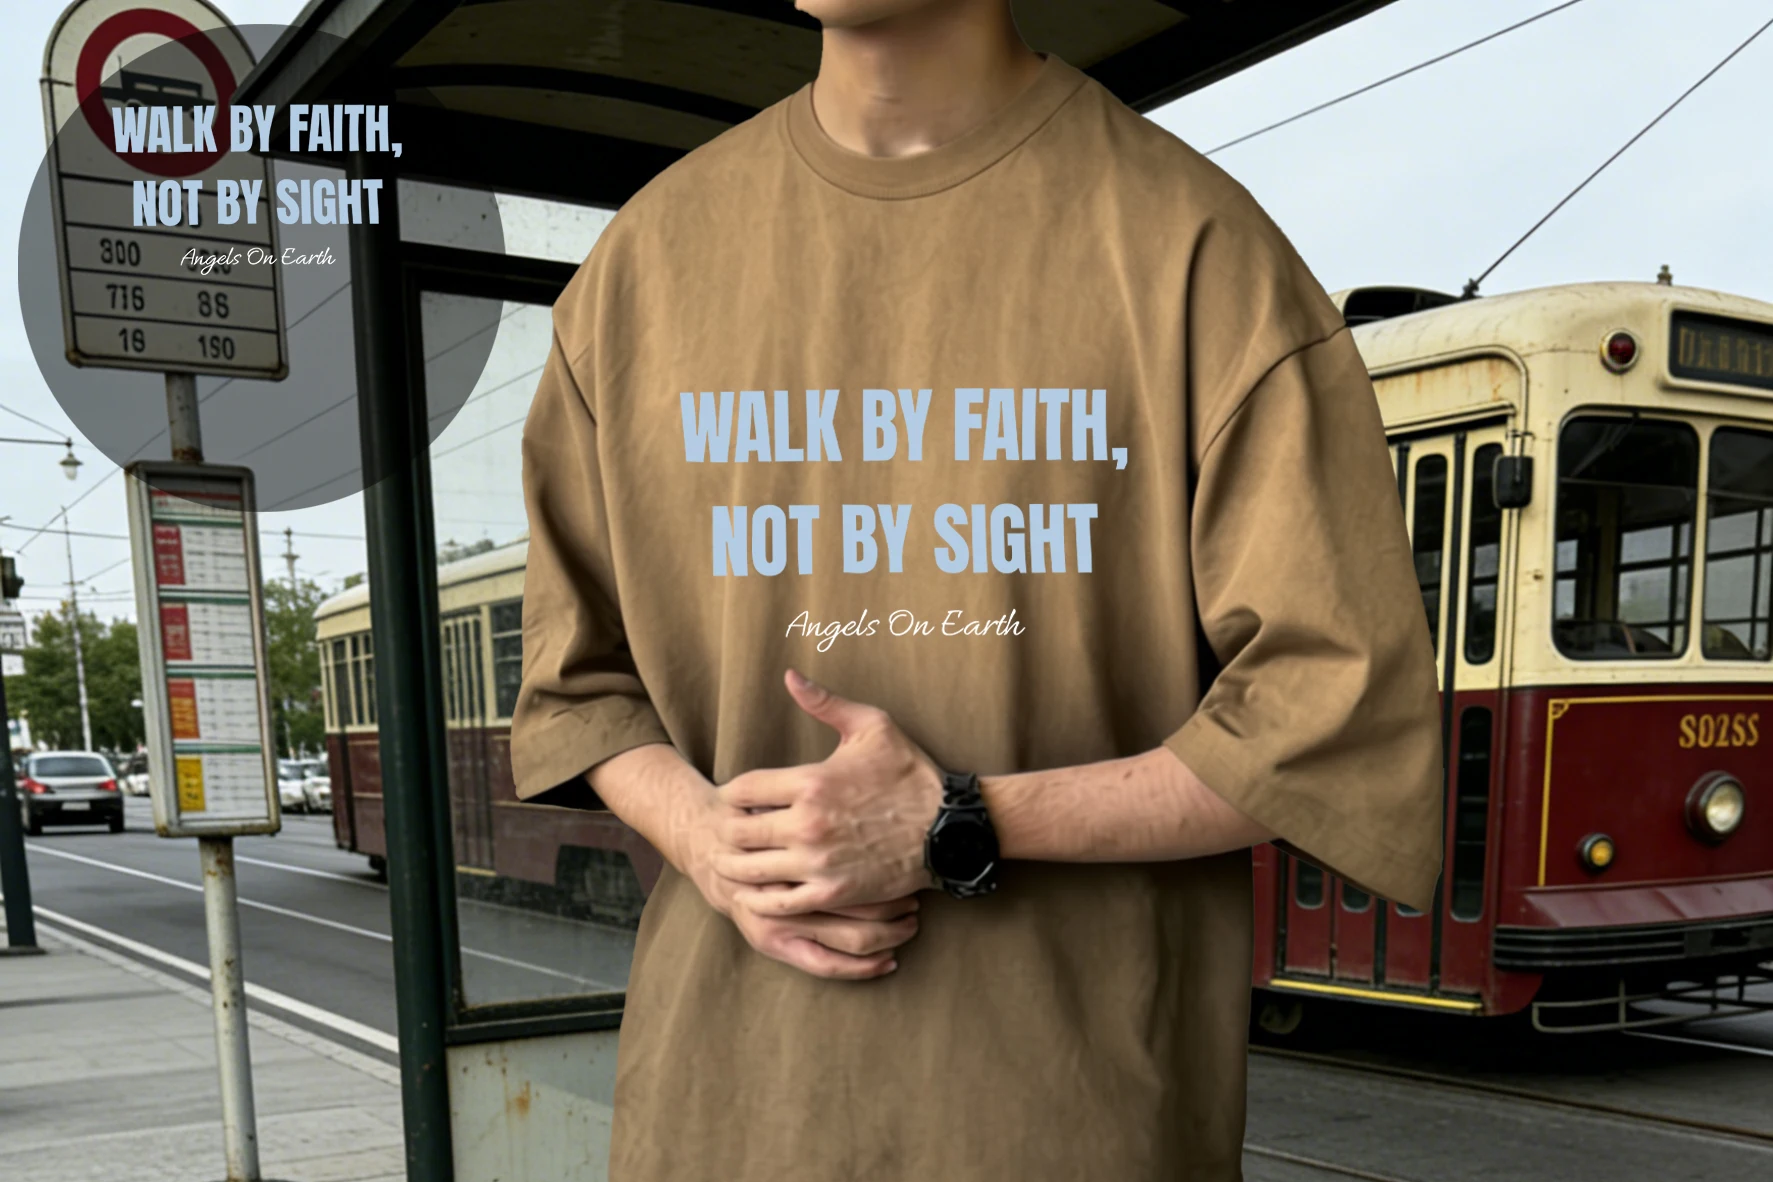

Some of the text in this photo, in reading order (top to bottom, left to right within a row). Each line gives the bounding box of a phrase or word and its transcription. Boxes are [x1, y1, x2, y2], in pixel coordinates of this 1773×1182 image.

[680, 388, 1128, 470] WALK BY FAITH,
[712, 503, 1098, 577] NOT BY SIGHT
[785, 608, 1026, 653] Angels On Earth
